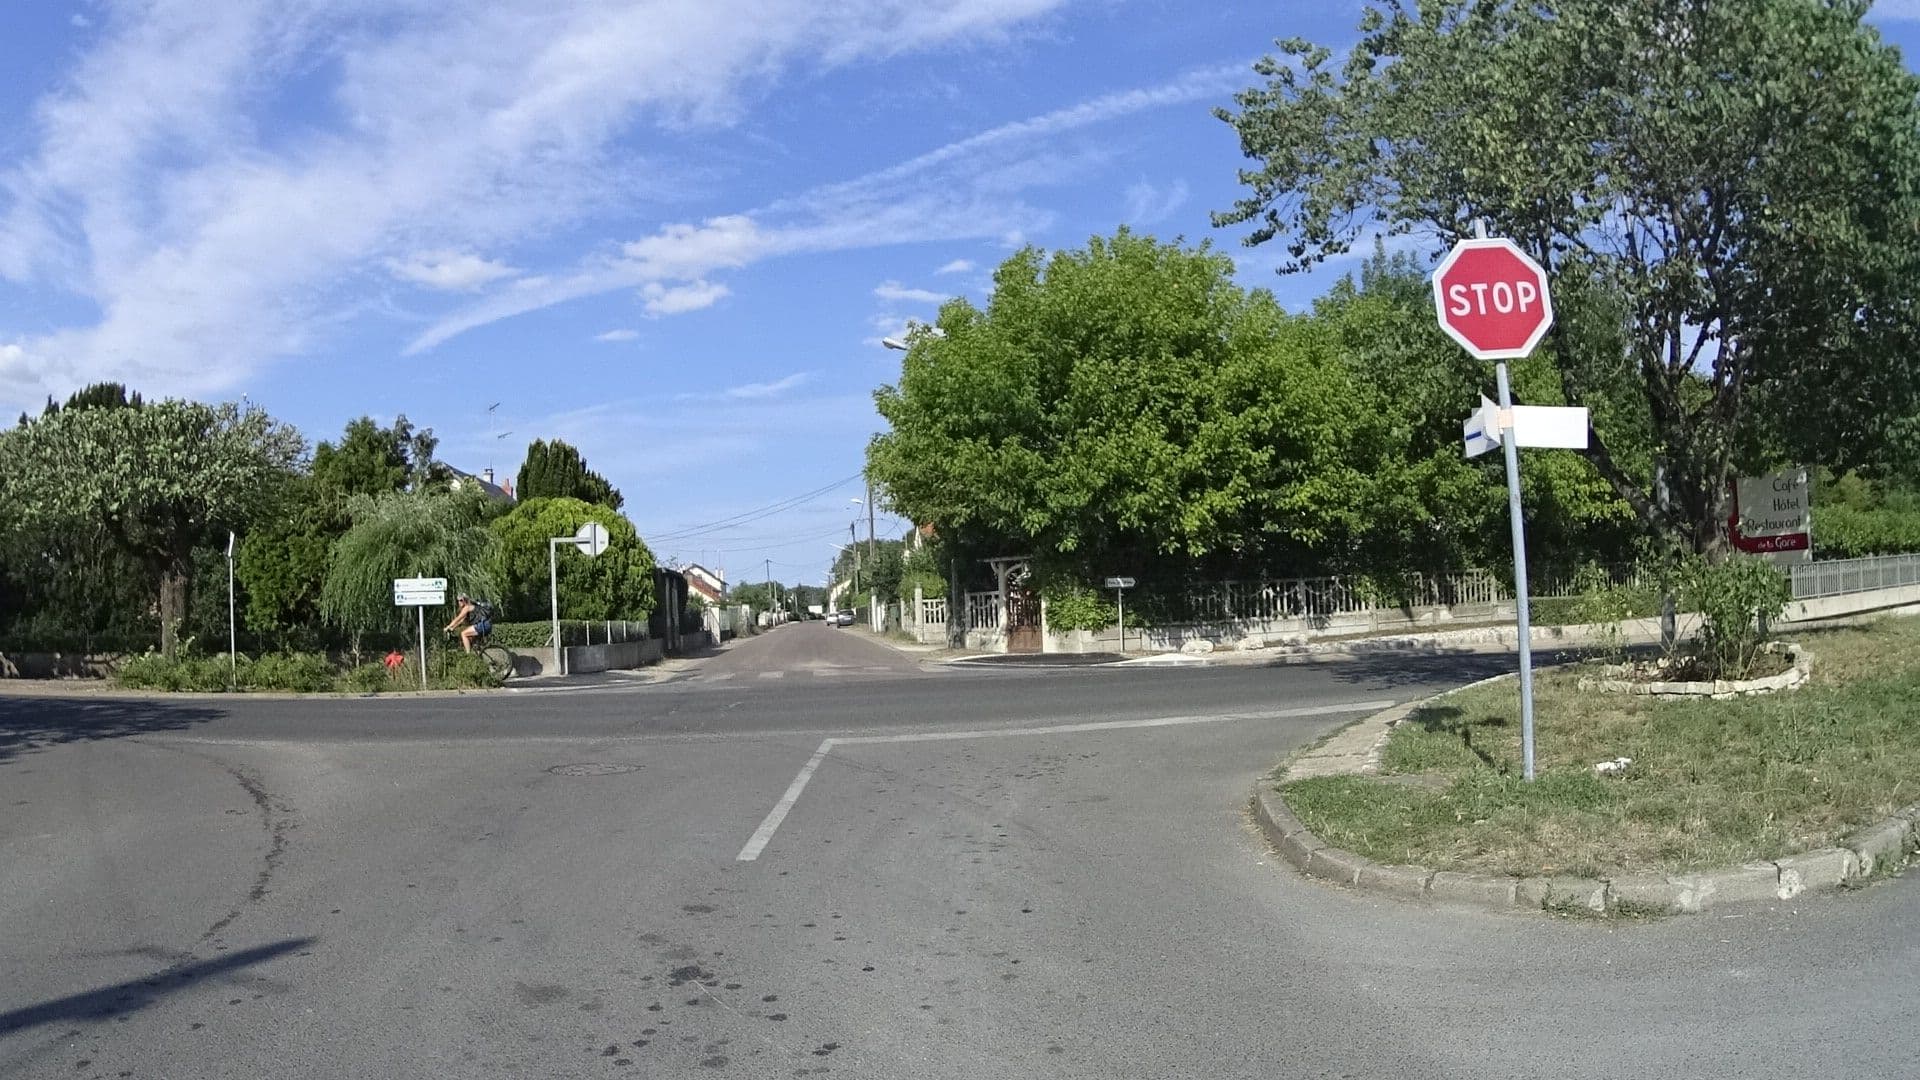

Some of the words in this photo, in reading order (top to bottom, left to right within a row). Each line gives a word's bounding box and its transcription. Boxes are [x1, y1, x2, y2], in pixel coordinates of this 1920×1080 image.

[1449, 281, 1536, 316] STOP
[1747, 515, 1801, 531] Restaurant
[1775, 537, 1797, 549] Gare
